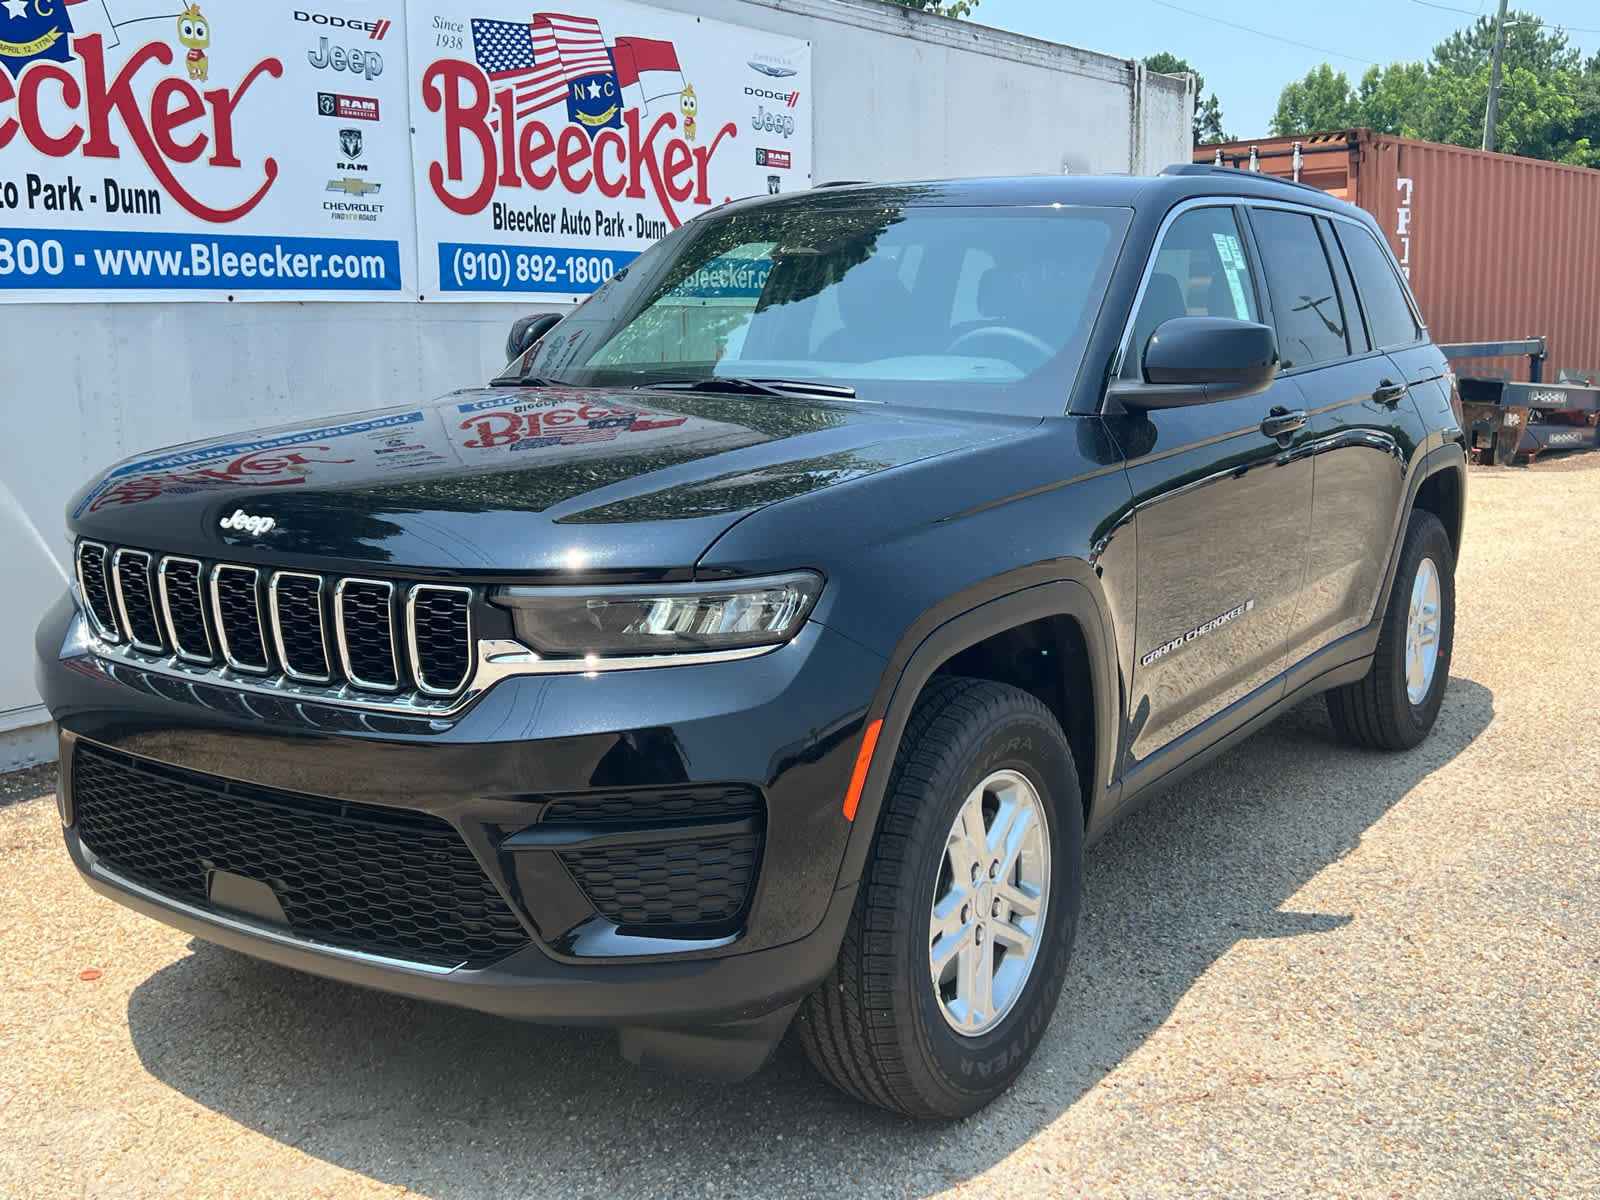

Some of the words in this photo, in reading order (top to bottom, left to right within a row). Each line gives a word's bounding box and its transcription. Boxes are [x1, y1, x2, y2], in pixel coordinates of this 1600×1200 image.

[294, 10, 378, 33] DODGE
[432, 15, 464, 33] Since
[436, 34, 463, 50] 1938
[307, 36, 383, 81] Jeep
[340, 98, 376, 110] RAM
[744, 87, 793, 102] DODGE
[0, 33, 283, 224] cker
[752, 105, 794, 139] Jeep
[422, 58, 737, 228] Bleecker
[768, 151, 789, 161] RAM
[336, 162, 368, 171] RAM
[26, 173, 84, 211] Park
[103, 178, 161, 214] Dunn
[323, 201, 384, 213] CHEVROLET
[492, 202, 556, 233] Bleecker
[560, 207, 592, 236] Auto
[595, 209, 625, 237] Park
[636, 212, 667, 240] Dunn
[93, 241, 386, 280] www.Bleecker.com
[453, 247, 511, 287] (910)
[516, 253, 613, 284] 892-1800
[219, 508, 277, 537] Jeep
[1141, 637, 1185, 667] GRAND
[1184, 603, 1246, 642] CHEROKEE
